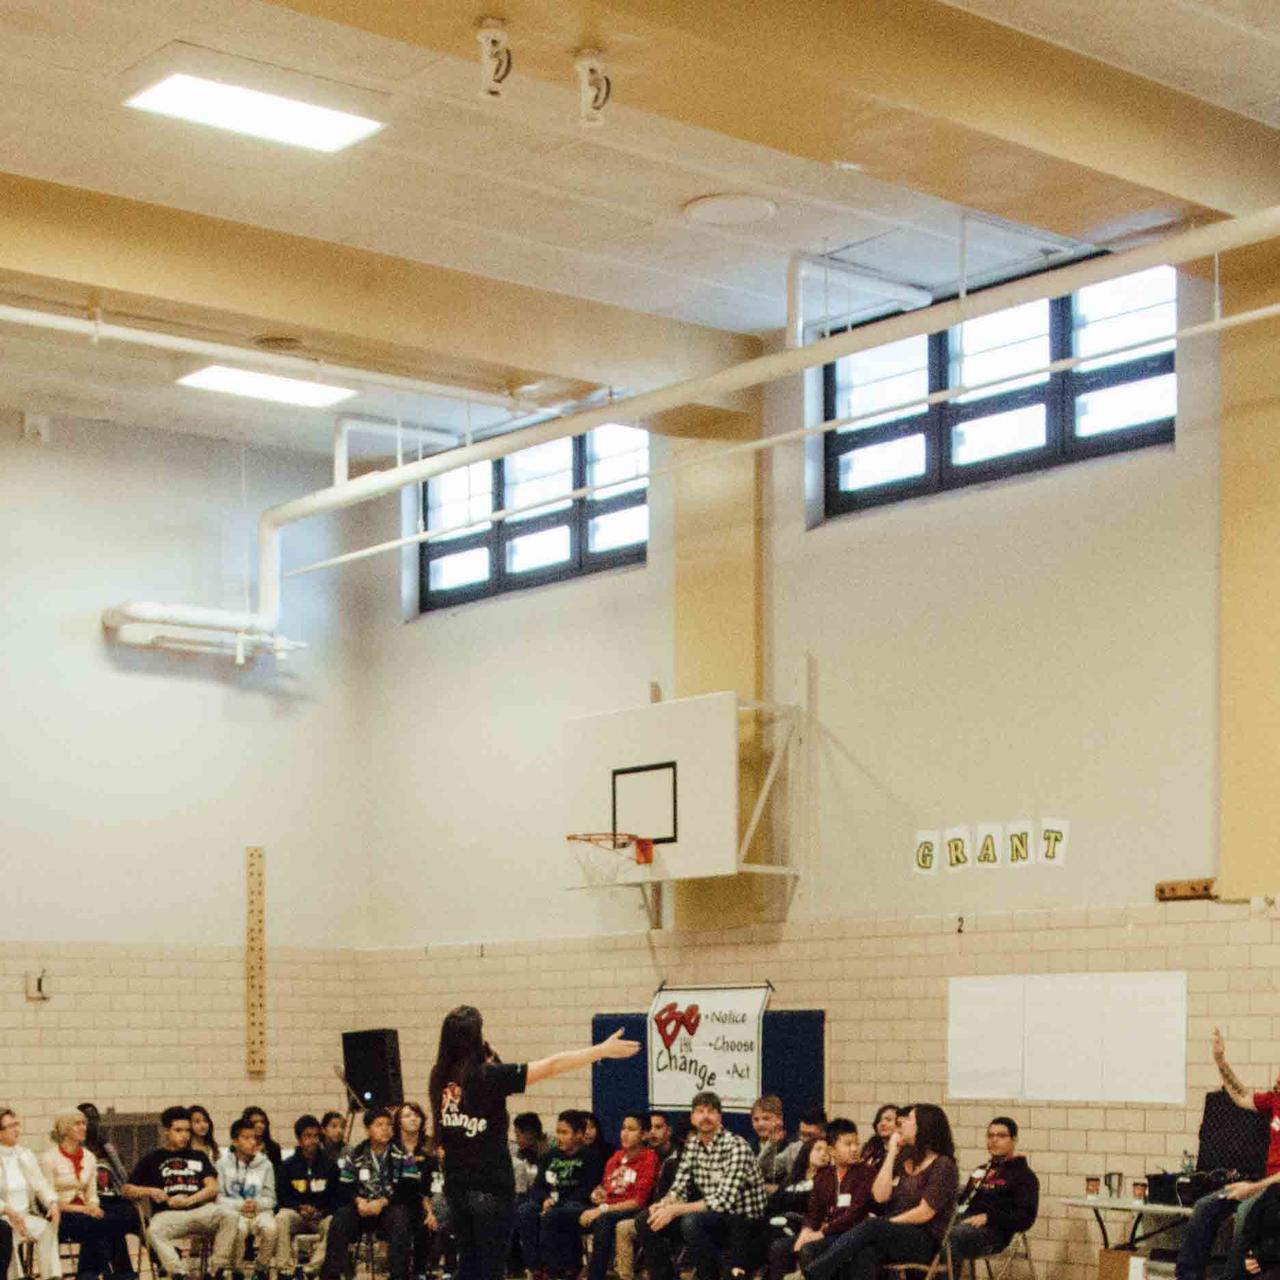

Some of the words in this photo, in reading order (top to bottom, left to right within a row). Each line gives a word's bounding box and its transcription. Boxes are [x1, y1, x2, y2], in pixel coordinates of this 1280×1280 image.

[917, 829, 1063, 869] GRANT
[957, 916, 965, 934] 2
[713, 1035, 755, 1053] Choose
[656, 1048, 717, 1091] Change
[731, 1062, 751, 1079] Act
[442, 1112, 487, 1137] hange
